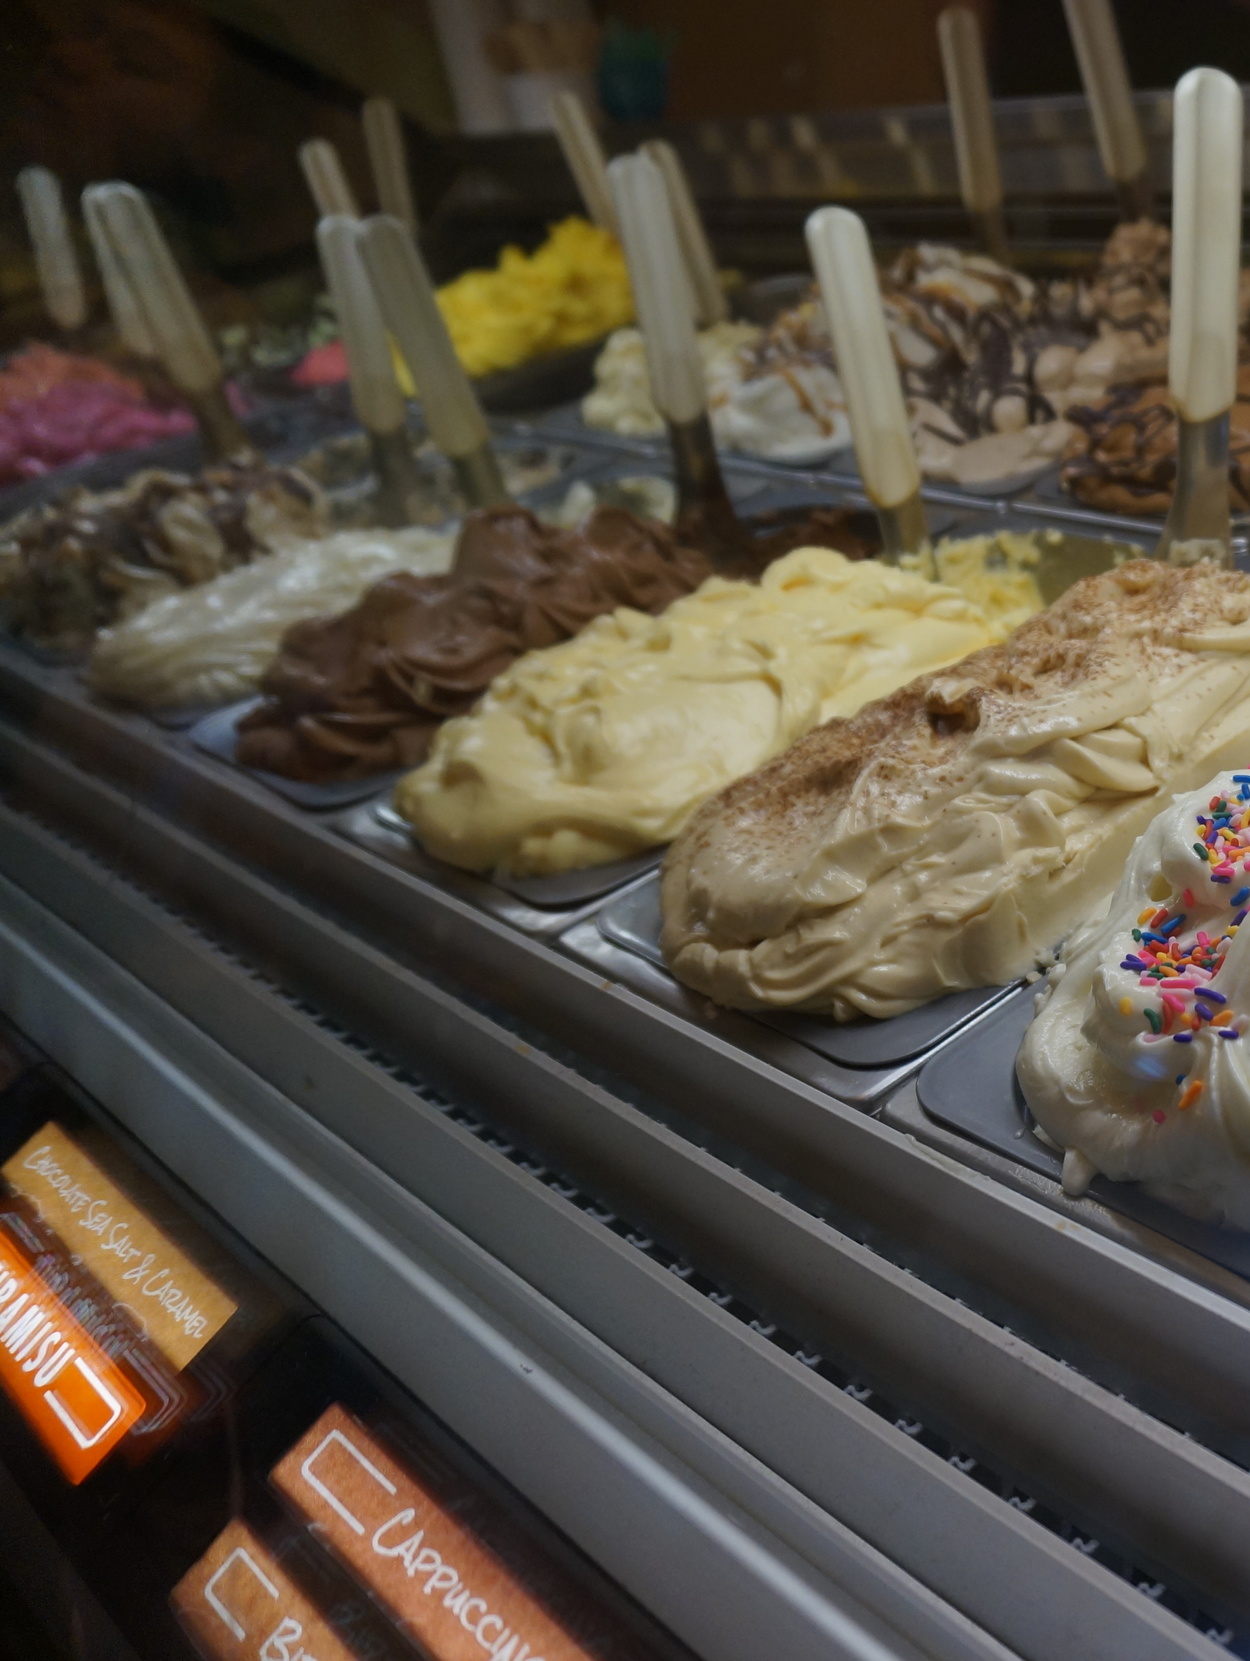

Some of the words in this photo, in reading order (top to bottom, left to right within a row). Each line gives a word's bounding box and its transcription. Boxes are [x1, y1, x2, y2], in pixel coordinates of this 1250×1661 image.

[0, 1261, 75, 1387] AMISU
[79, 1199, 113, 1235] SEA
[101, 1222, 142, 1263] SALT
[122, 1253, 156, 1285] &
[142, 1268, 209, 1338] CARAMEL
[372, 1507, 546, 1661] CAPPUCCIN
